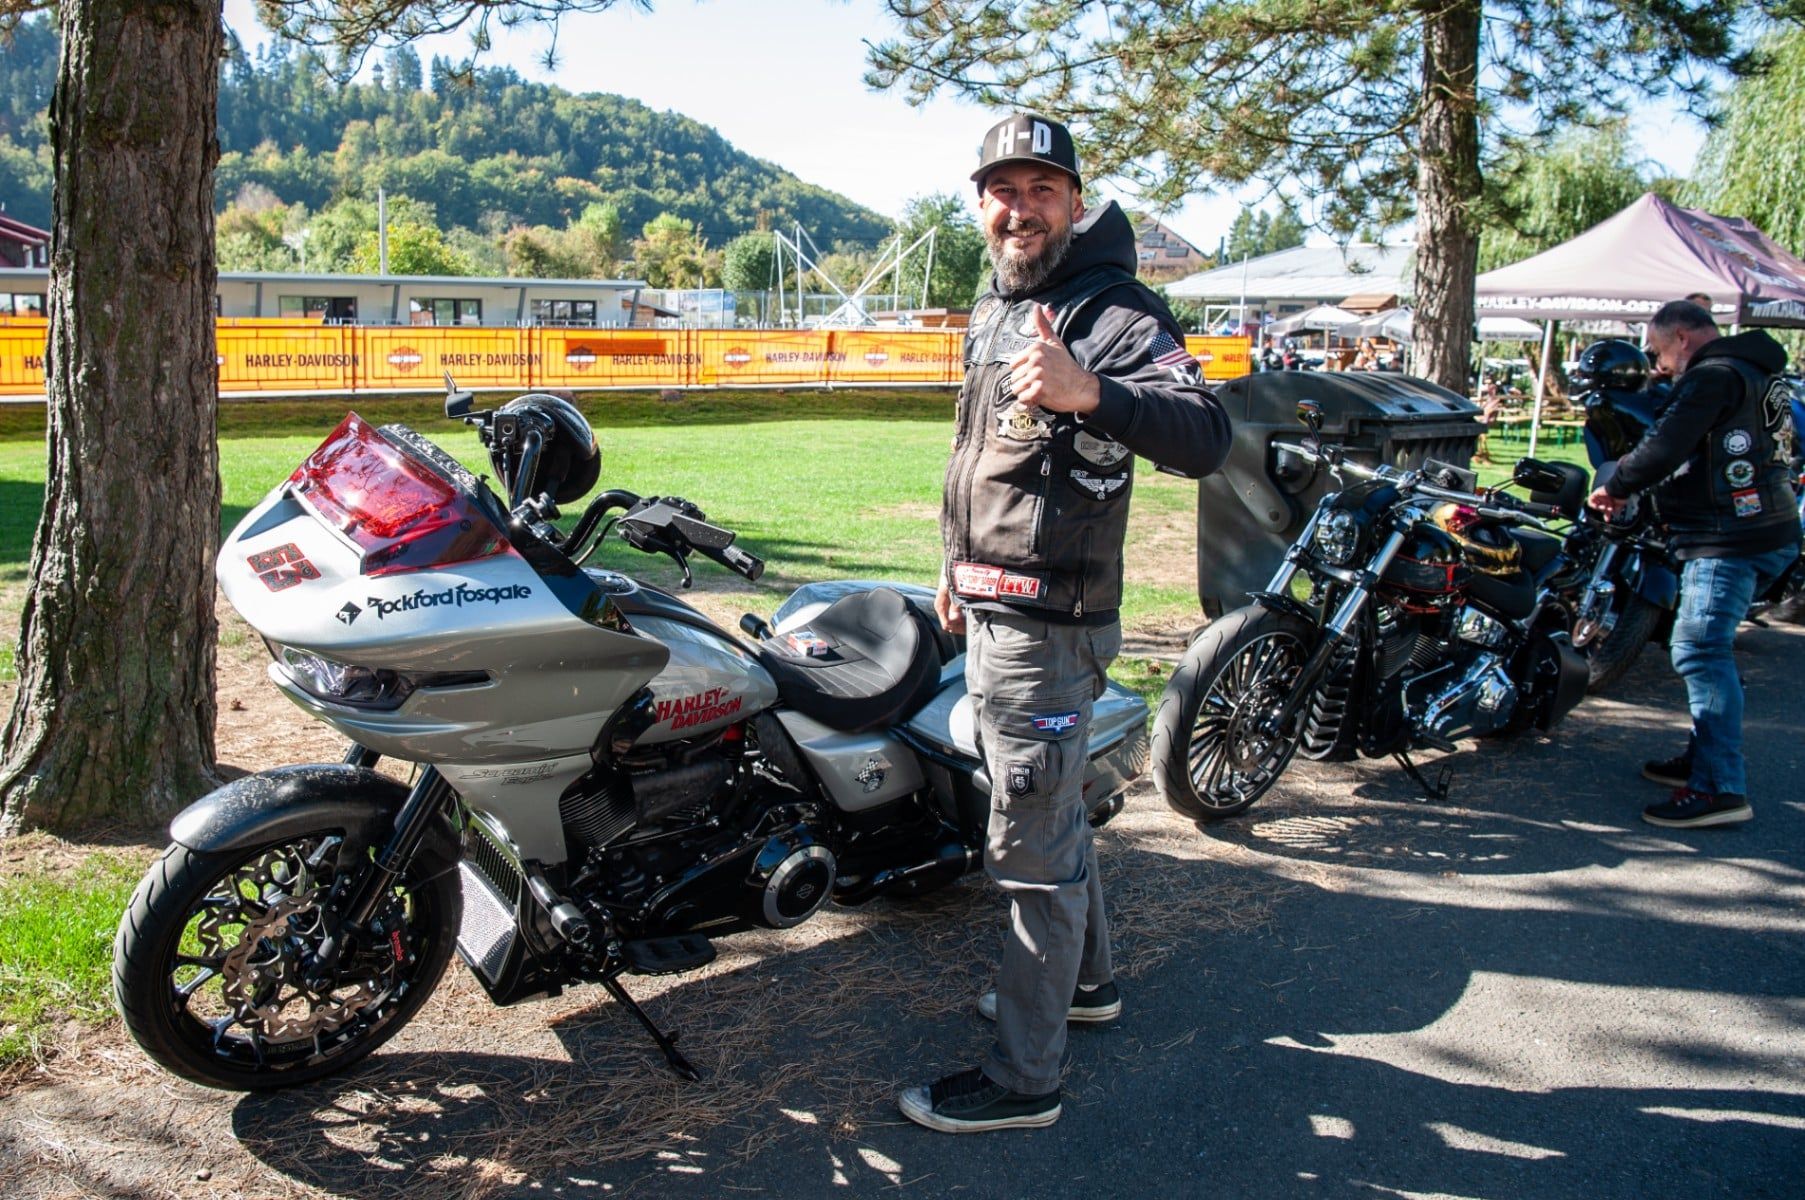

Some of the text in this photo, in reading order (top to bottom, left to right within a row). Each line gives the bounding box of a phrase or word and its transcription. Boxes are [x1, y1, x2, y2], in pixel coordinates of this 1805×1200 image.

[996, 121, 1051, 157] H-D
[245, 354, 359, 368] HARLEY-DAVIDSON
[440, 353, 542, 366] HARLEY-DAVIDSON
[612, 353, 701, 365] HARLEY-DAVIDSON
[765, 351, 847, 363] HARLEY-DAVIDSON
[671, 696, 742, 731] DAVIDSON
